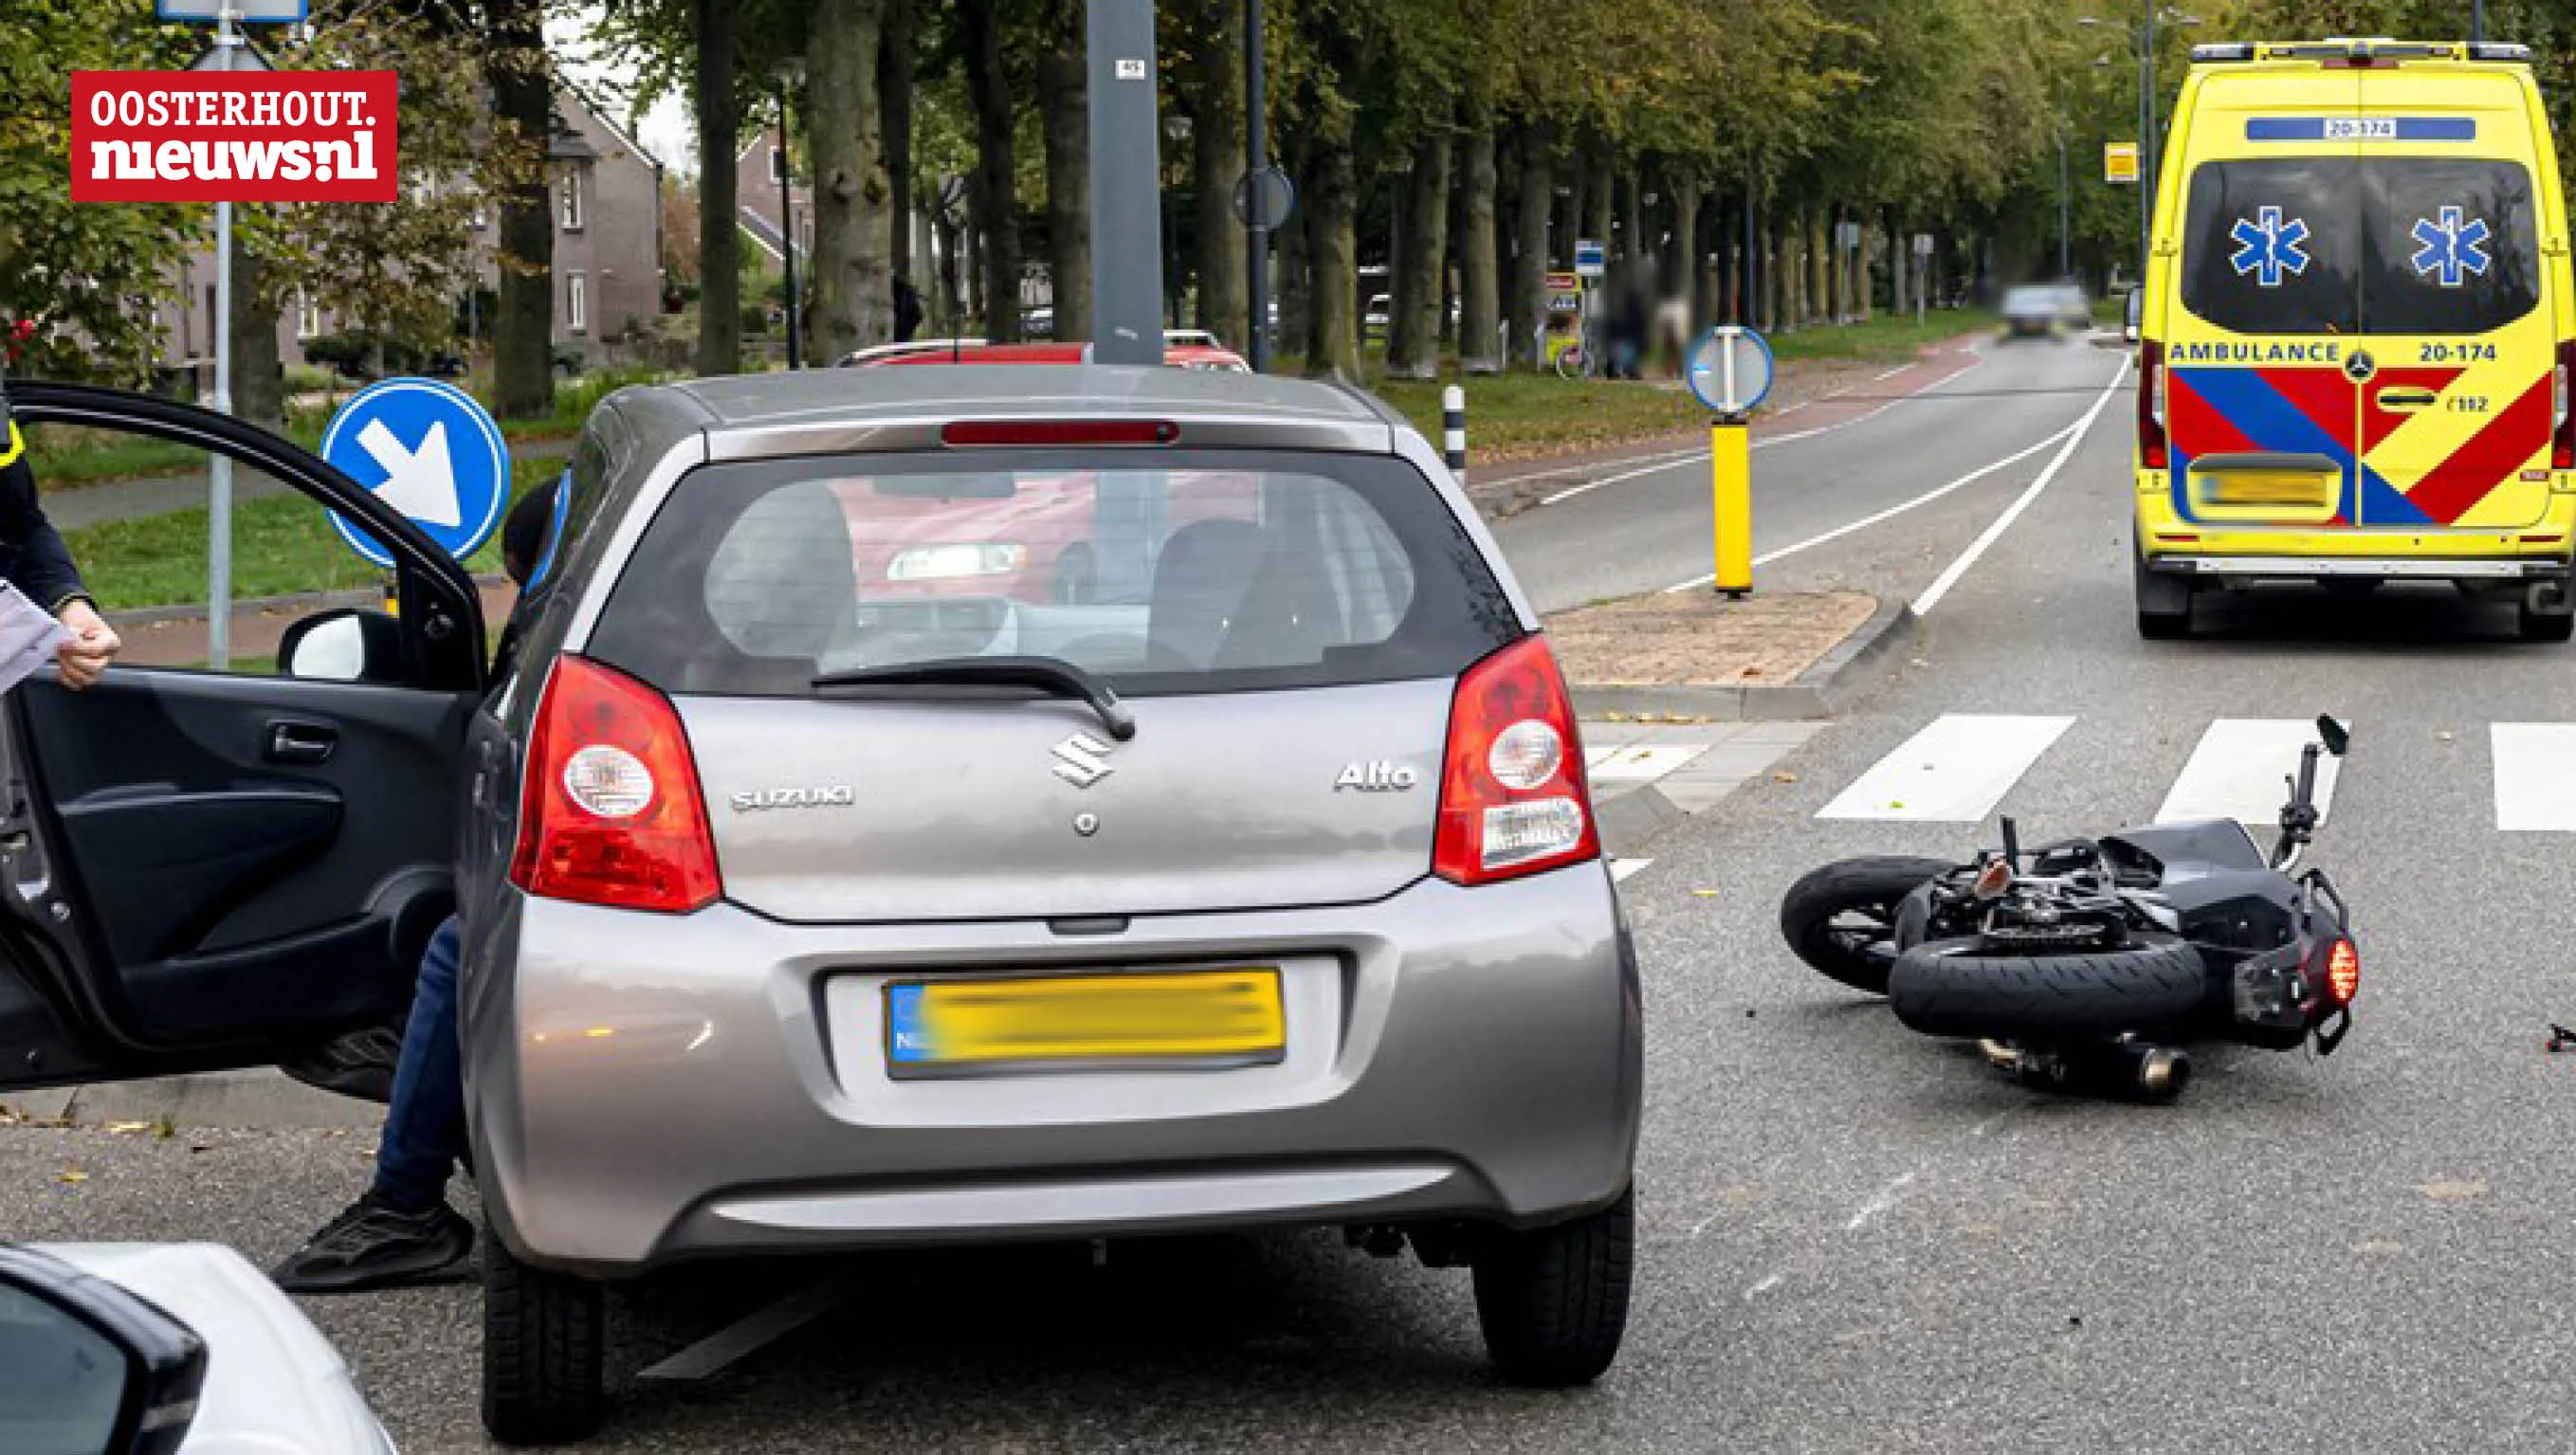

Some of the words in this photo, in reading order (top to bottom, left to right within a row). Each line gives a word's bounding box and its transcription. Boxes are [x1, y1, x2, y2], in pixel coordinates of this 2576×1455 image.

[2170, 342, 2339, 361] AMBULANCE
[2420, 342, 2496, 361] 20-174
[1333, 760, 1416, 792] Alto
[731, 785, 854, 811] SUZUKI
